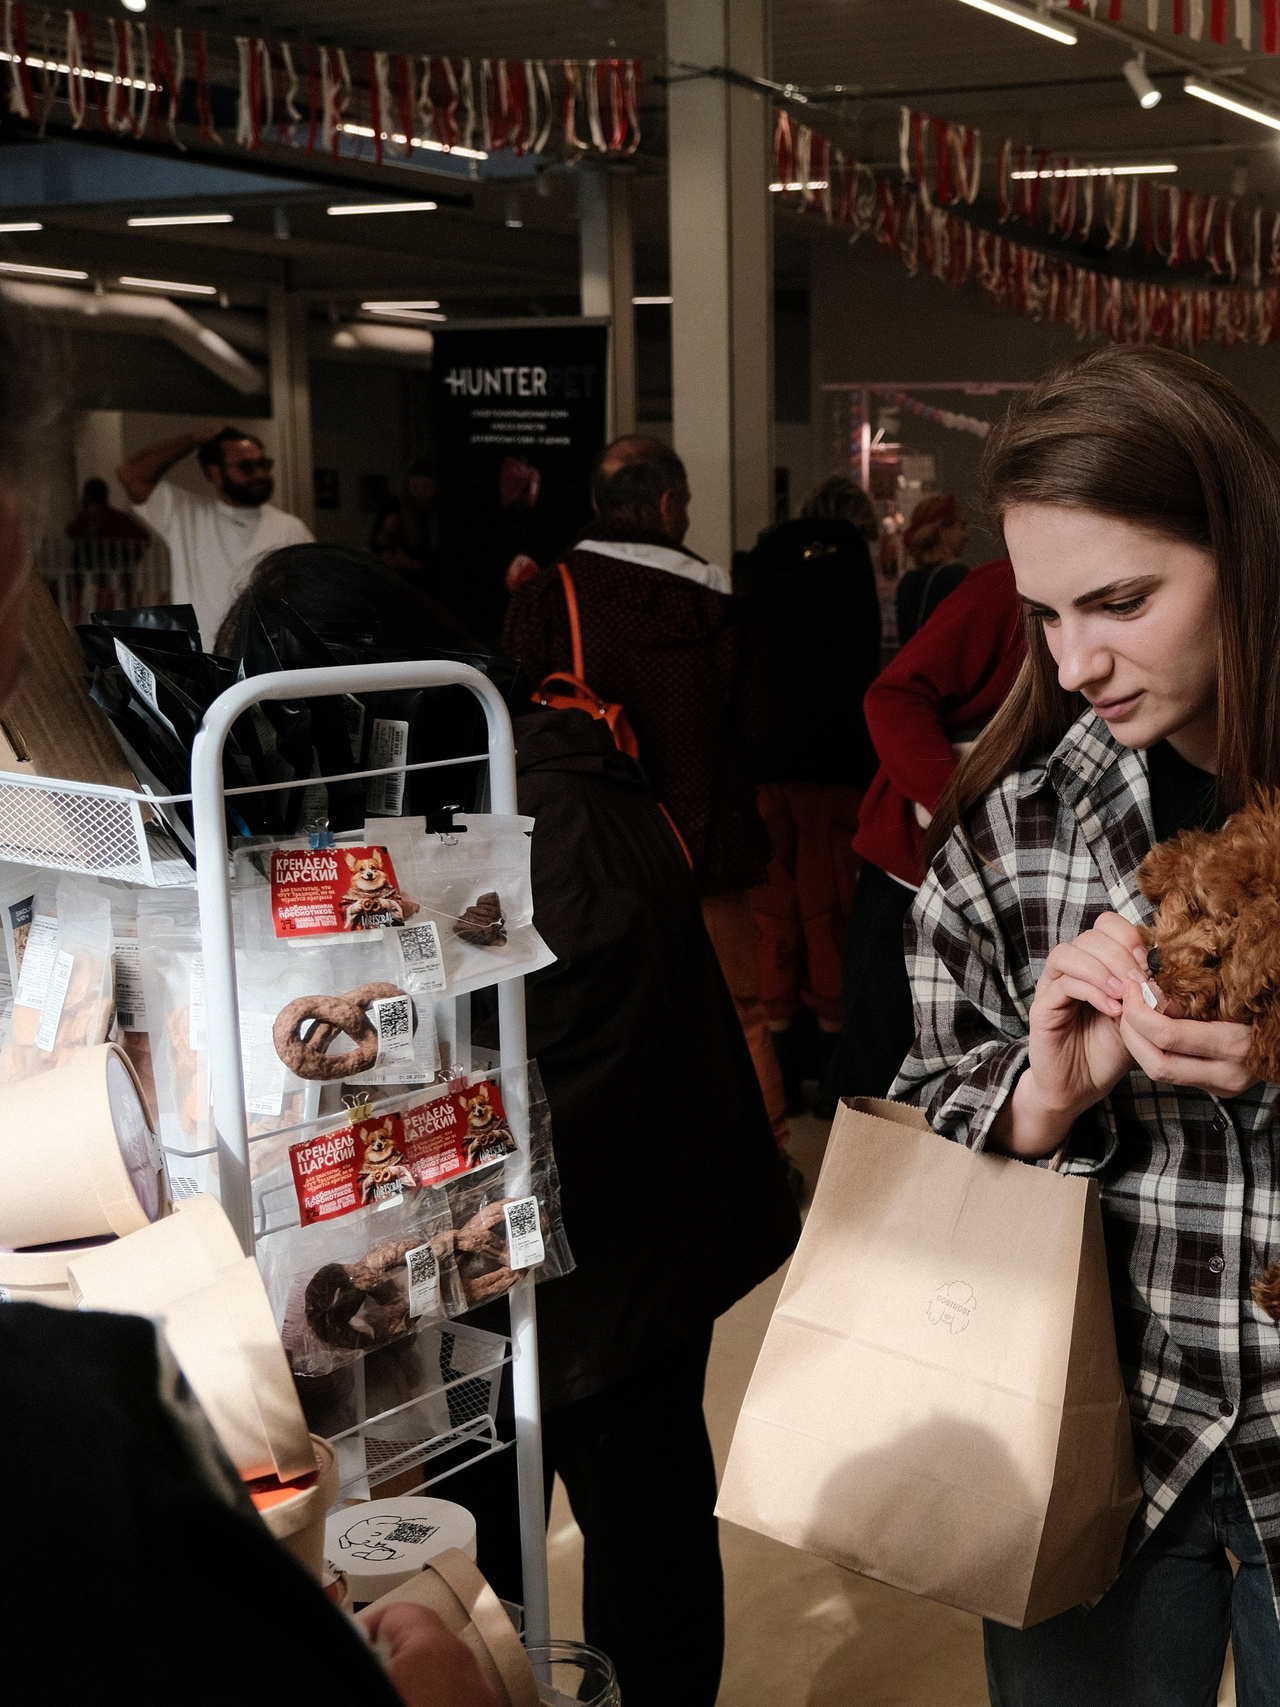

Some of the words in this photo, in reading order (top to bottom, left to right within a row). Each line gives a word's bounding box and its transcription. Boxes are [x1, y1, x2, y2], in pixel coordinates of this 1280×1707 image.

[276, 857, 338, 873] КРЕНДЕЛЬ
[403, 1103, 455, 1130] РЕНДЕЛЬ
[297, 1135, 354, 1163] КРЕНДЕЛЬ
